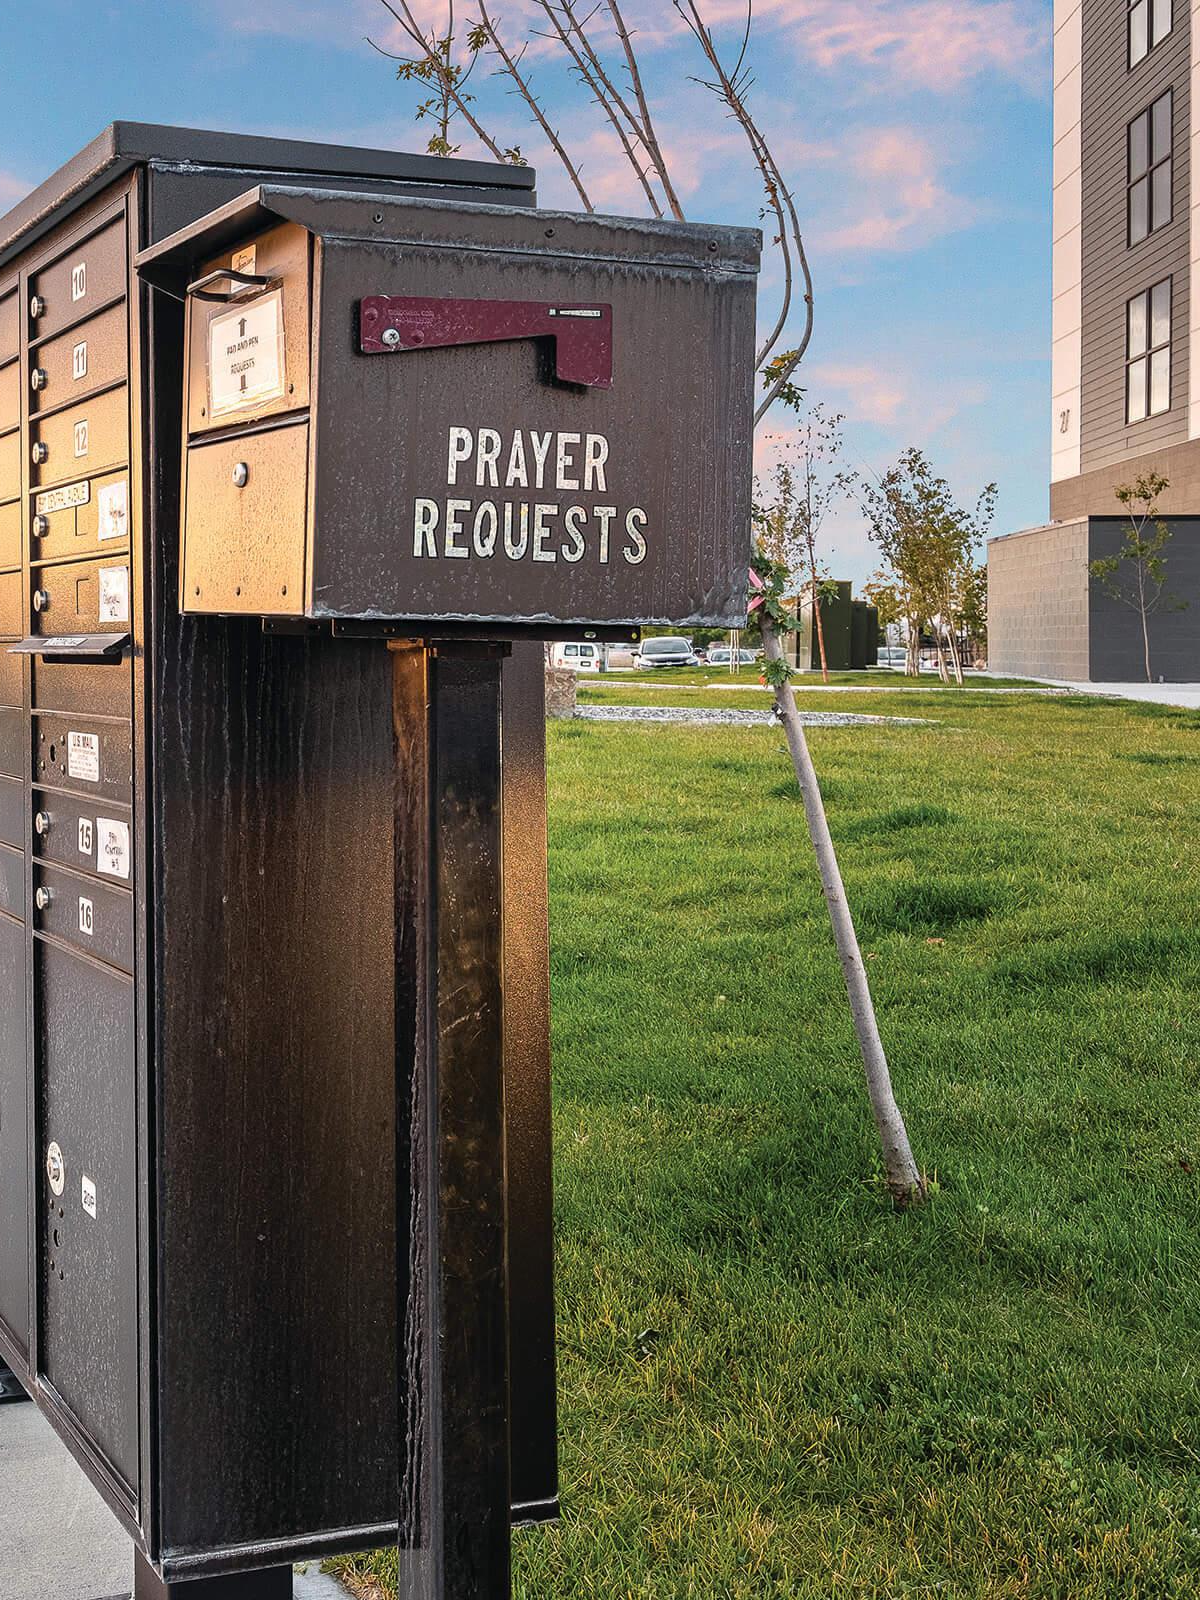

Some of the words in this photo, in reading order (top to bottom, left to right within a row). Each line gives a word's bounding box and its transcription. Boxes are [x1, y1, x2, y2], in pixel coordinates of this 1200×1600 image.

[73, 268, 85, 296] 10
[237, 340, 248, 351] AND
[248, 336, 259, 347] PEN
[74, 346, 86, 373] 11
[75, 427, 87, 451] 12
[447, 426, 609, 492] PRAYER
[413, 497, 648, 565] REQUESTS
[80, 824, 91, 850] 15
[80, 903, 92, 929] 16
